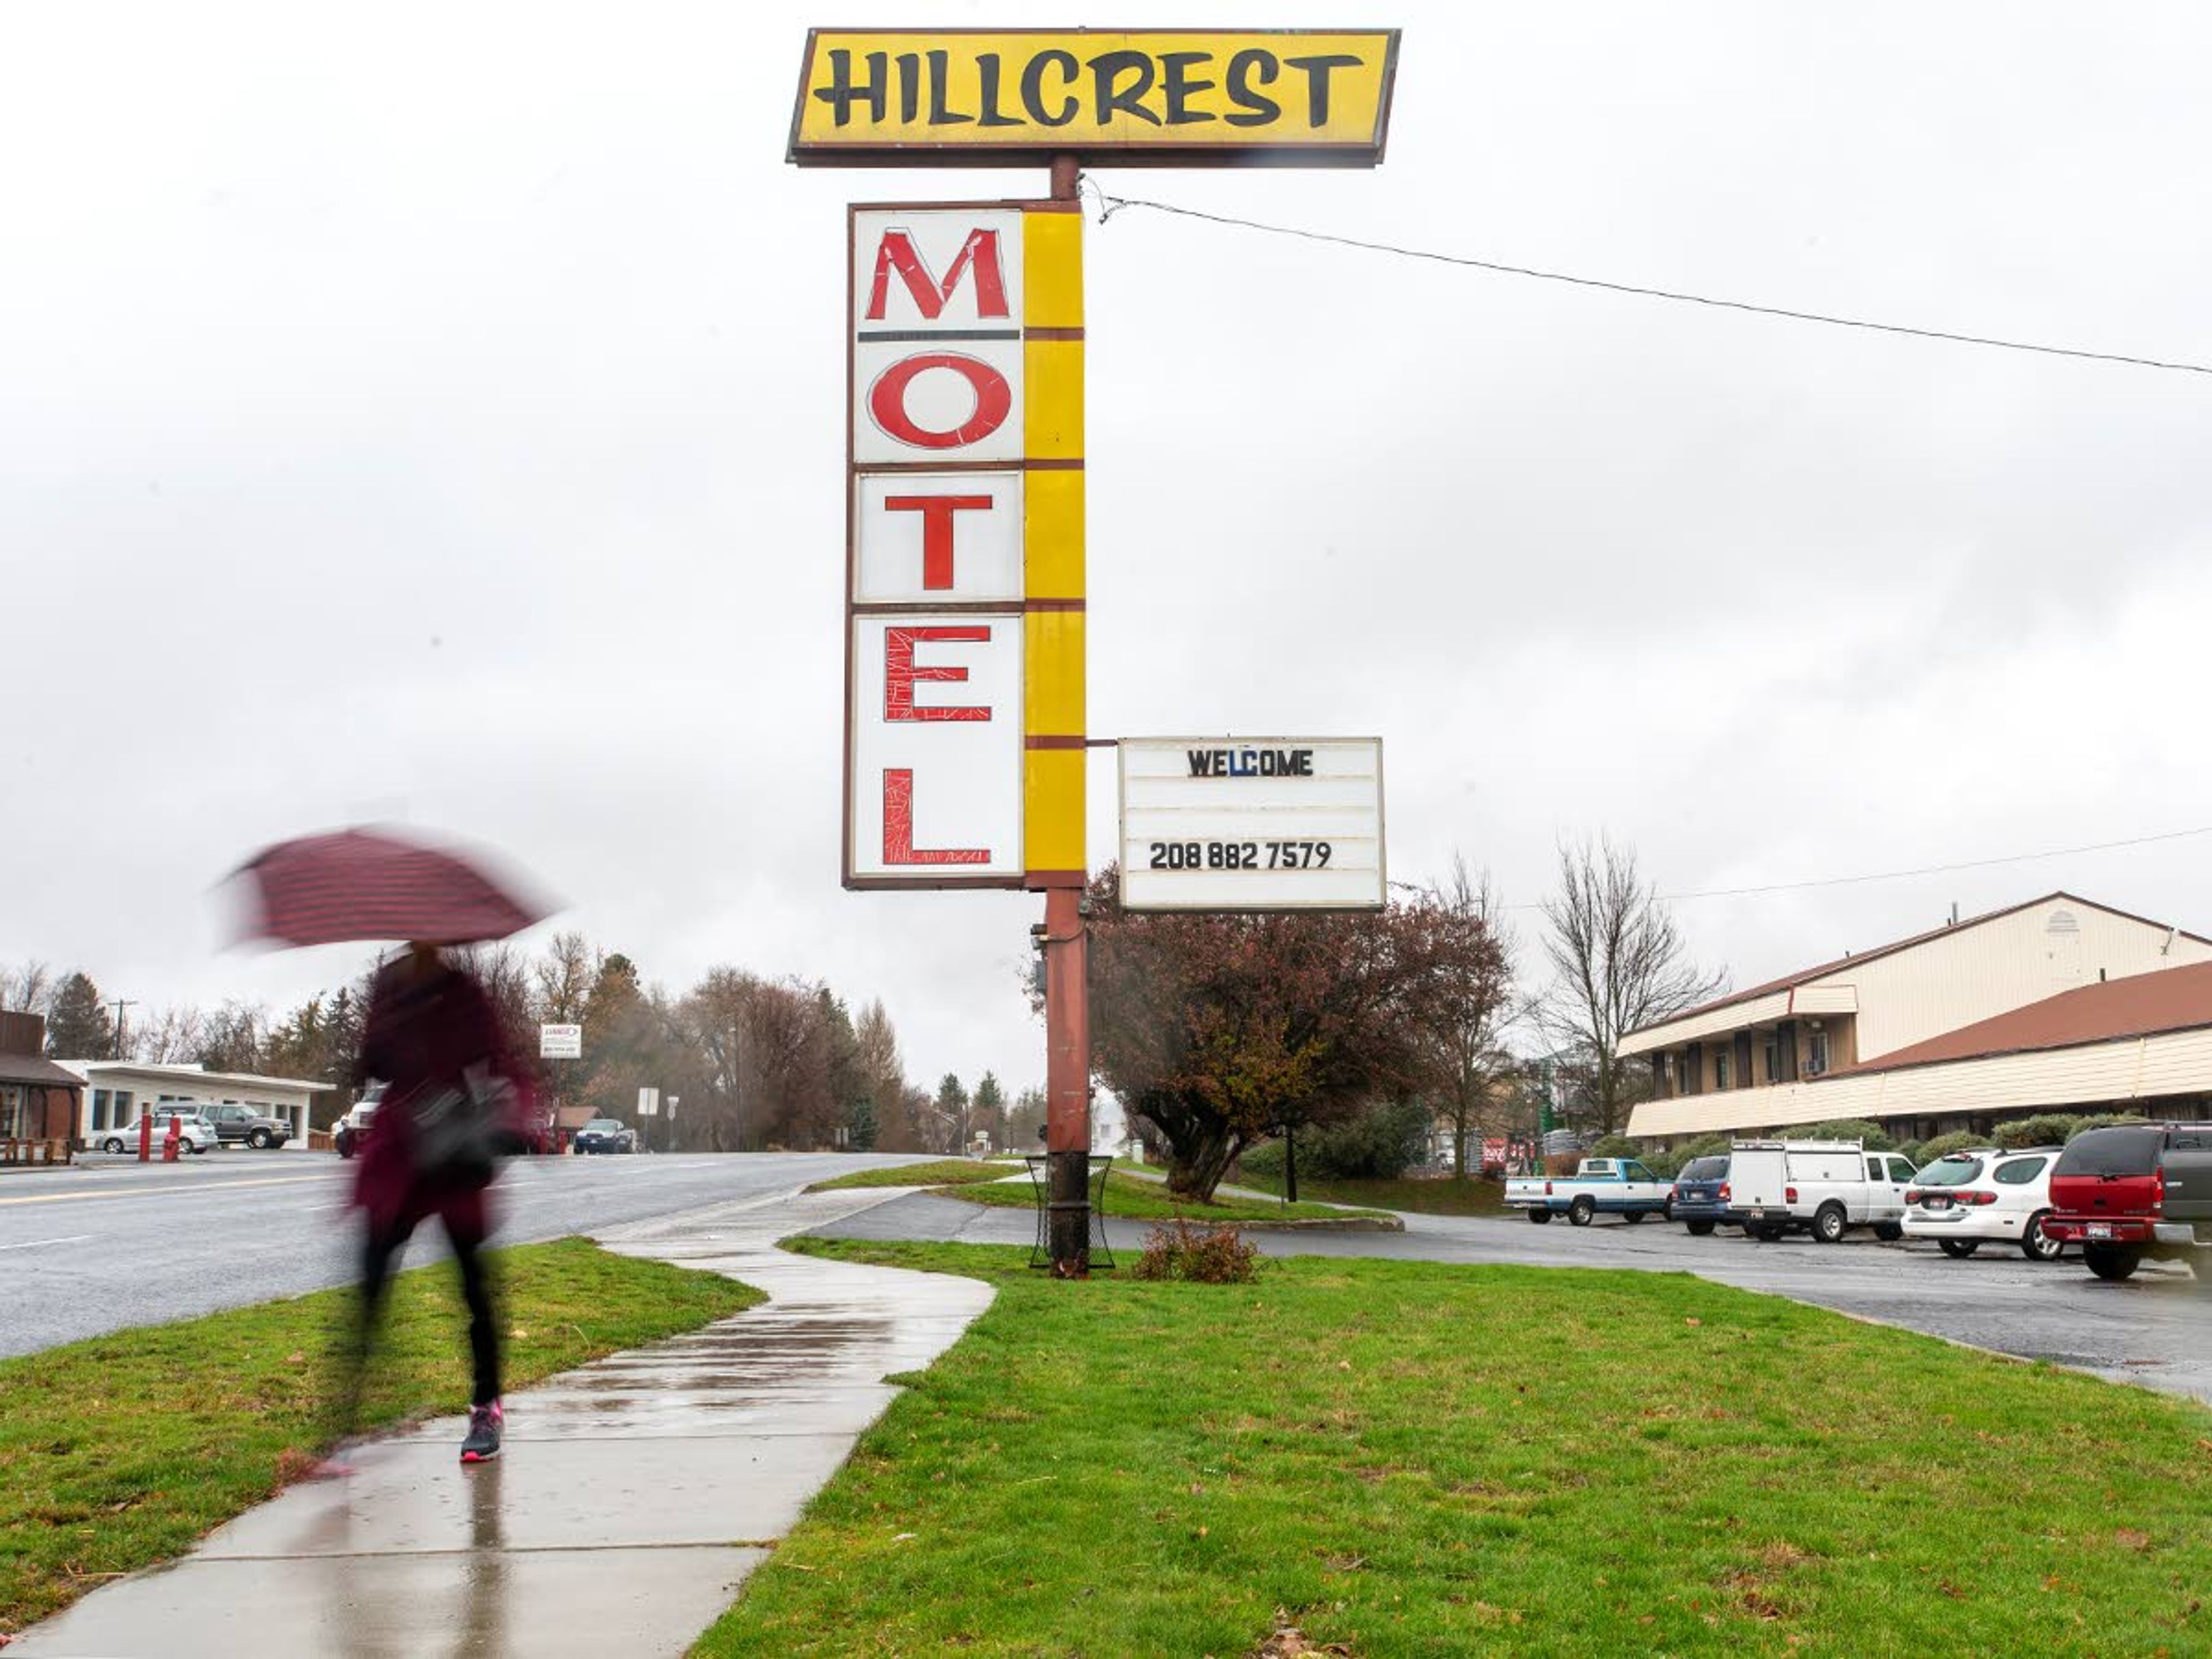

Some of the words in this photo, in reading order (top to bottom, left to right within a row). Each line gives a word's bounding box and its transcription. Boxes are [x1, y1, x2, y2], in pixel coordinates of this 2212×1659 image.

[813, 49, 1363, 127] HILLCREST
[865, 228, 1012, 864] MOTEL
[1187, 750, 1313, 777] WELCOME
[1150, 842, 1201, 869] 208
[1208, 842, 1258, 869] 882
[1266, 842, 1332, 869] 7579
